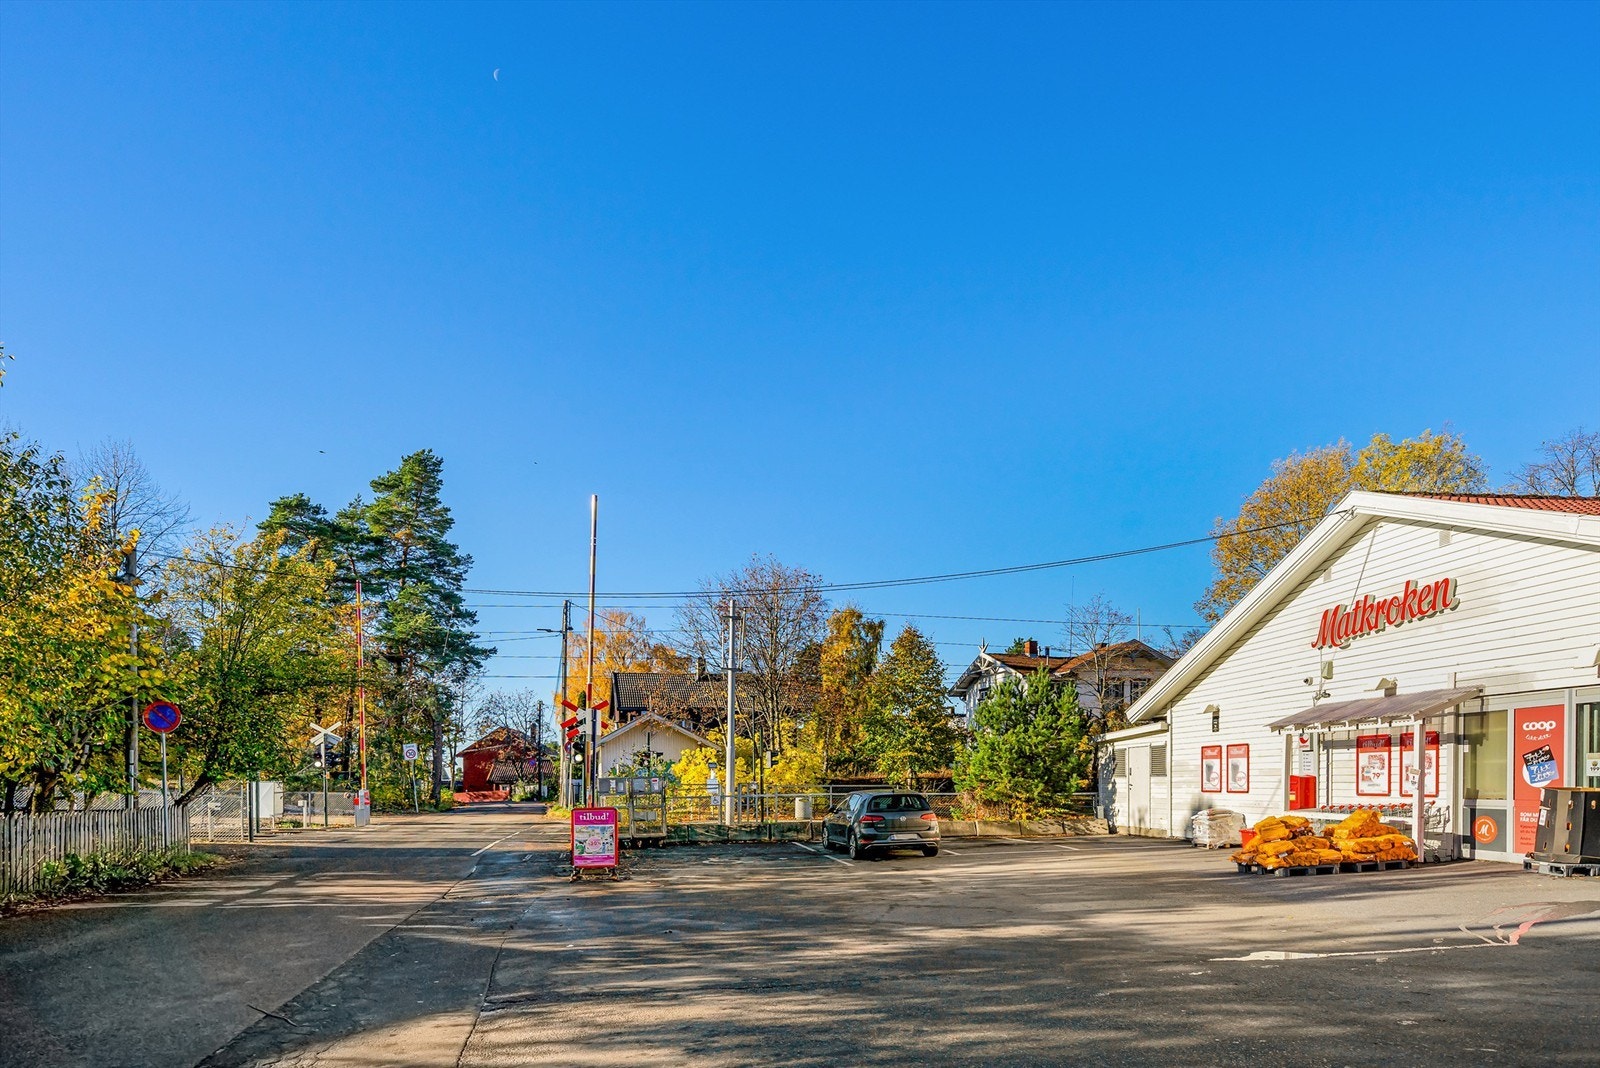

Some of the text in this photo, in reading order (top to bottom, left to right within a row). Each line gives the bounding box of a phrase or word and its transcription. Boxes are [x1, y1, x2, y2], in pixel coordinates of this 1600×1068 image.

[1311, 577, 1453, 649] Matkroken
[1522, 720, 1556, 732] coop
[579, 812, 609, 820] tilbud!
